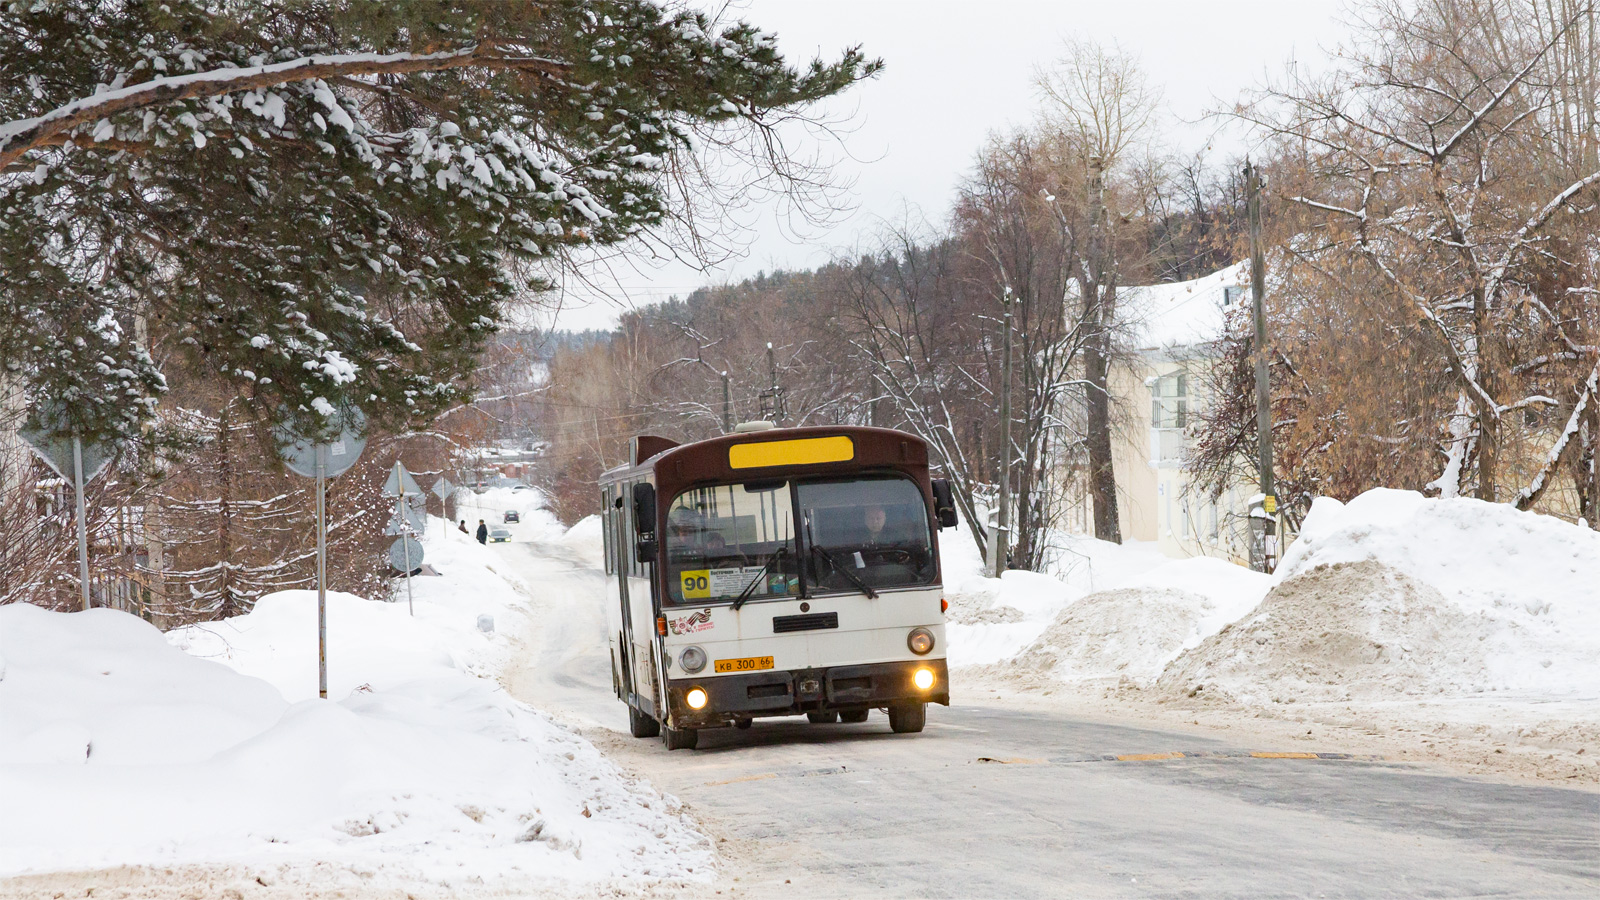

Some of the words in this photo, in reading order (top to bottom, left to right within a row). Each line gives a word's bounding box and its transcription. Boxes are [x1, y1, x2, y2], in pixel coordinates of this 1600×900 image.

[684, 576, 708, 591] 90
[719, 662, 732, 671] КВ
[736, 659, 755, 670] 300
[760, 657, 770, 665] 66
